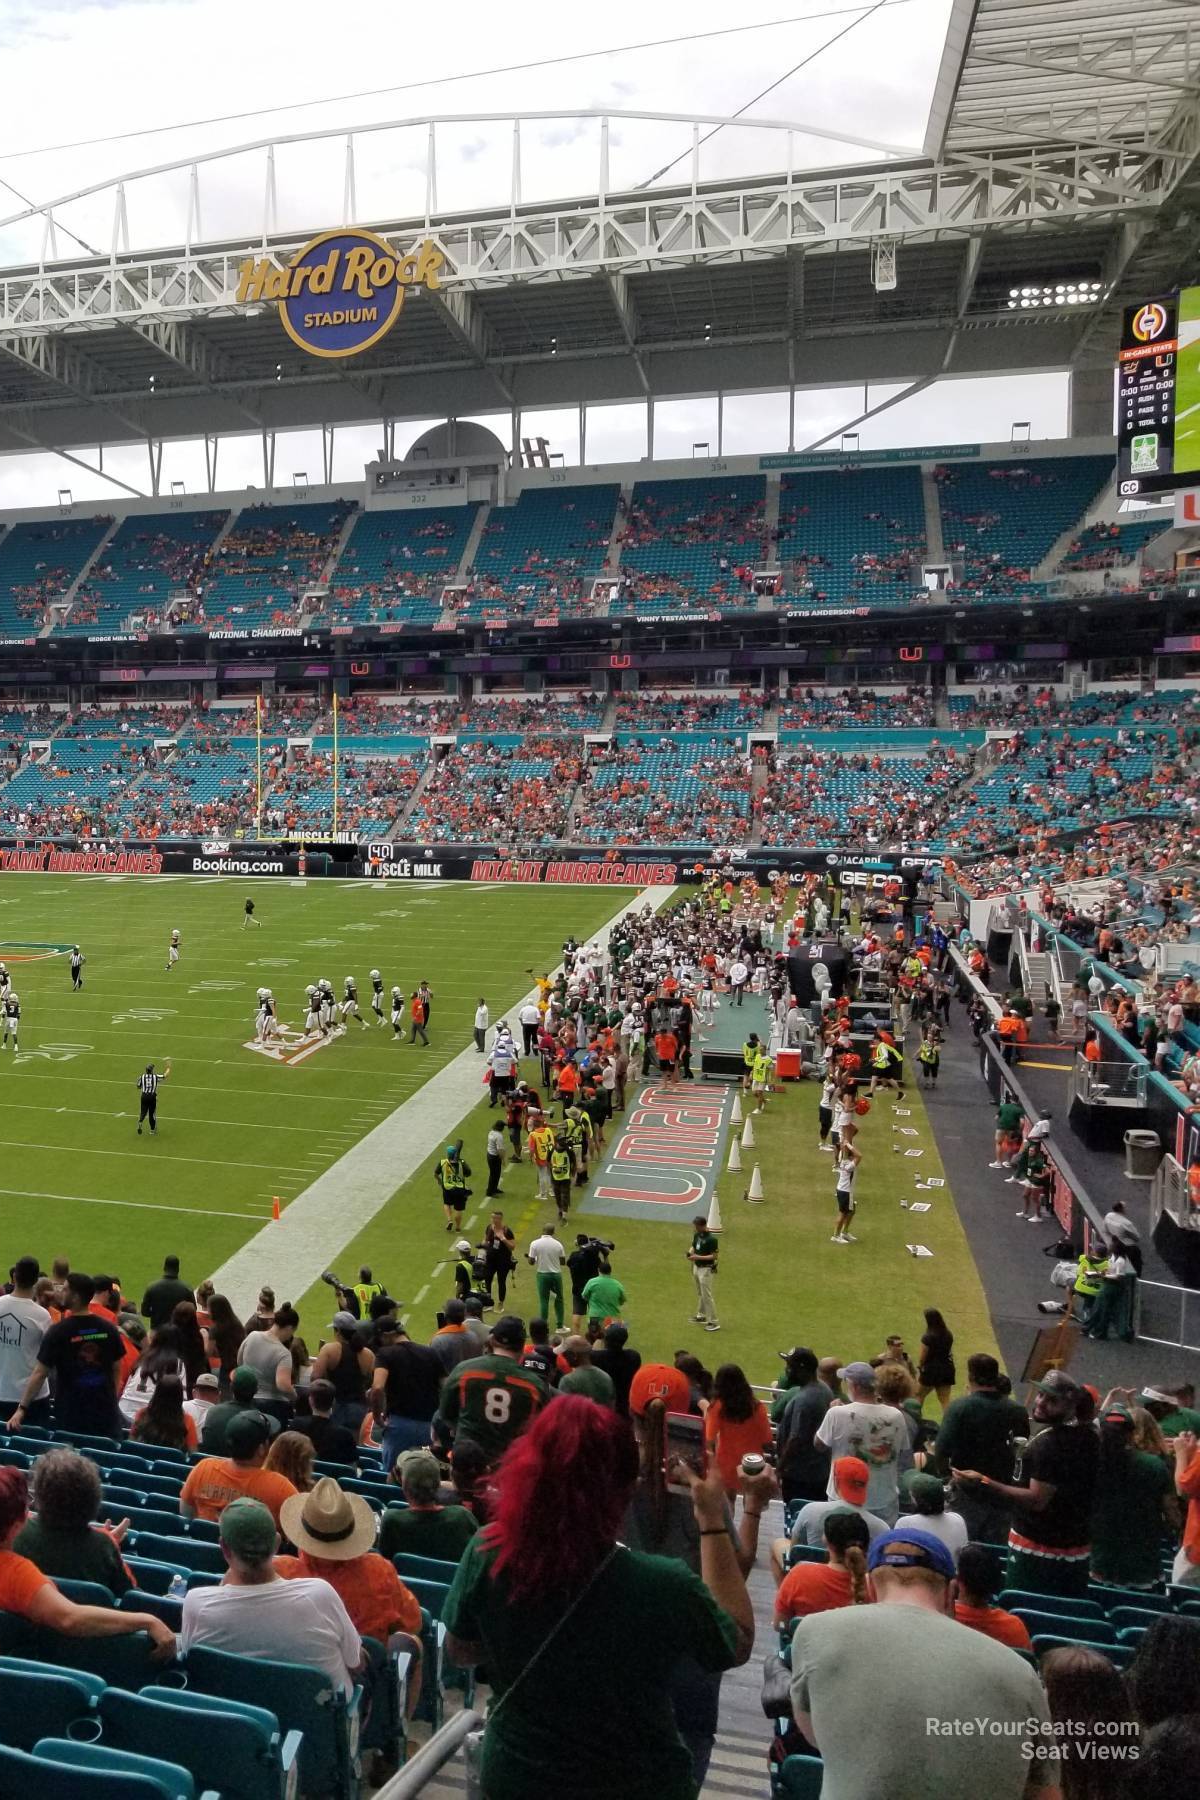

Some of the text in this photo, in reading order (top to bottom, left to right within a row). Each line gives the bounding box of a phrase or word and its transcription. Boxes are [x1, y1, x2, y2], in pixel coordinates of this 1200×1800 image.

[236, 238, 444, 302] Hard Rock
[303, 306, 377, 328] STADIUM
[1124, 343, 1173, 358] IN-GAME STATS
[1128, 376, 1134, 384] 0
[1163, 369, 1169, 377] 0
[1121, 386, 1138, 397] 0:00
[1156, 380, 1174, 390] 0:00
[1127, 399, 1133, 407] 0
[1162, 392, 1168, 400] 0
[1127, 416, 1168, 430] 0 TOTAL 0
[1122, 482, 1136, 493] CC
[660, 614, 709, 622] TESTAVERDE
[810, 608, 855, 617] ANDERSON
[208, 628, 303, 640] NATIONAL CHAMPIONS
[288, 831, 360, 844] MUSCLE MILK
[48, 851, 164, 874] HURRICANES
[192, 857, 284, 873] Booking.com
[413, 863, 443, 877] MILK
[470, 860, 679, 885] MIAMI HURRICANES
[14, 1043, 96, 1061] 20
[593, 1164, 707, 1205] U
[484, 1387, 512, 1424] 8
